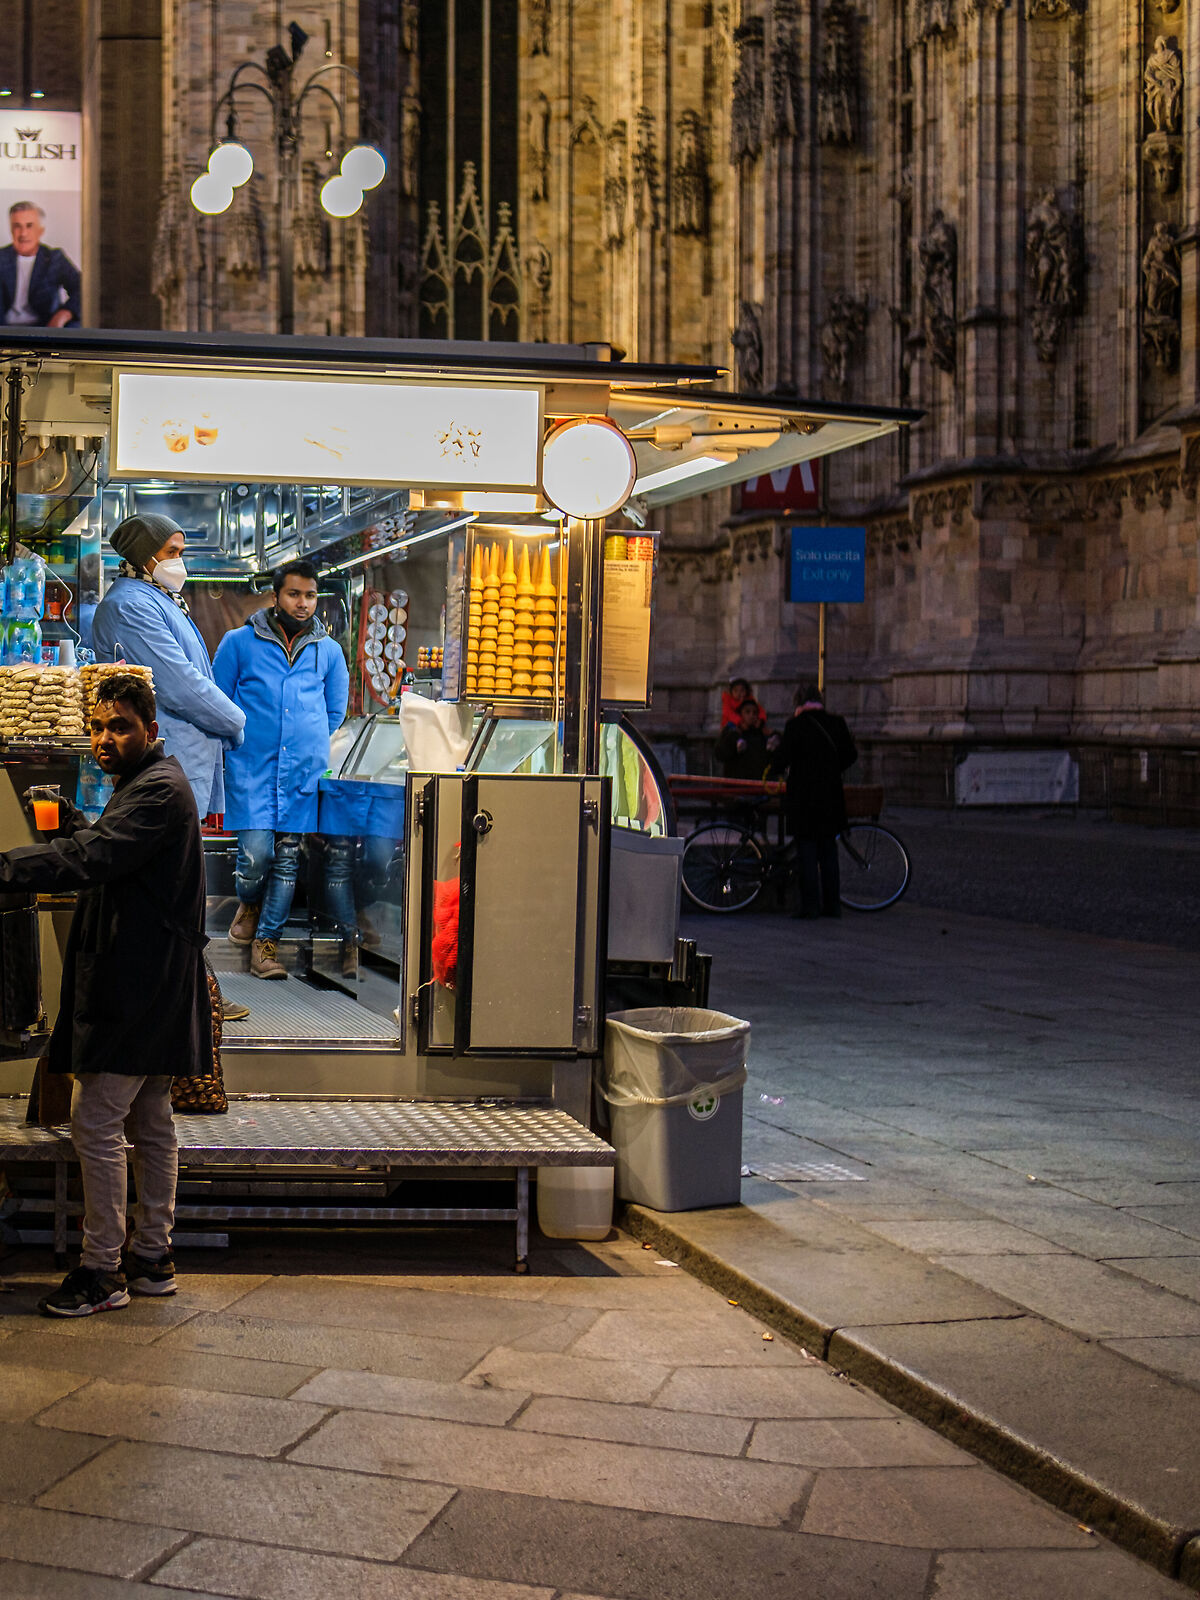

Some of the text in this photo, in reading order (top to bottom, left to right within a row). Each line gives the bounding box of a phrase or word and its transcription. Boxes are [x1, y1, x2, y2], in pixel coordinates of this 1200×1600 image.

[9, 164, 46, 173] ITALIA
[795, 549, 860, 561] Solo uscita
[802, 567, 851, 582] Exit only
